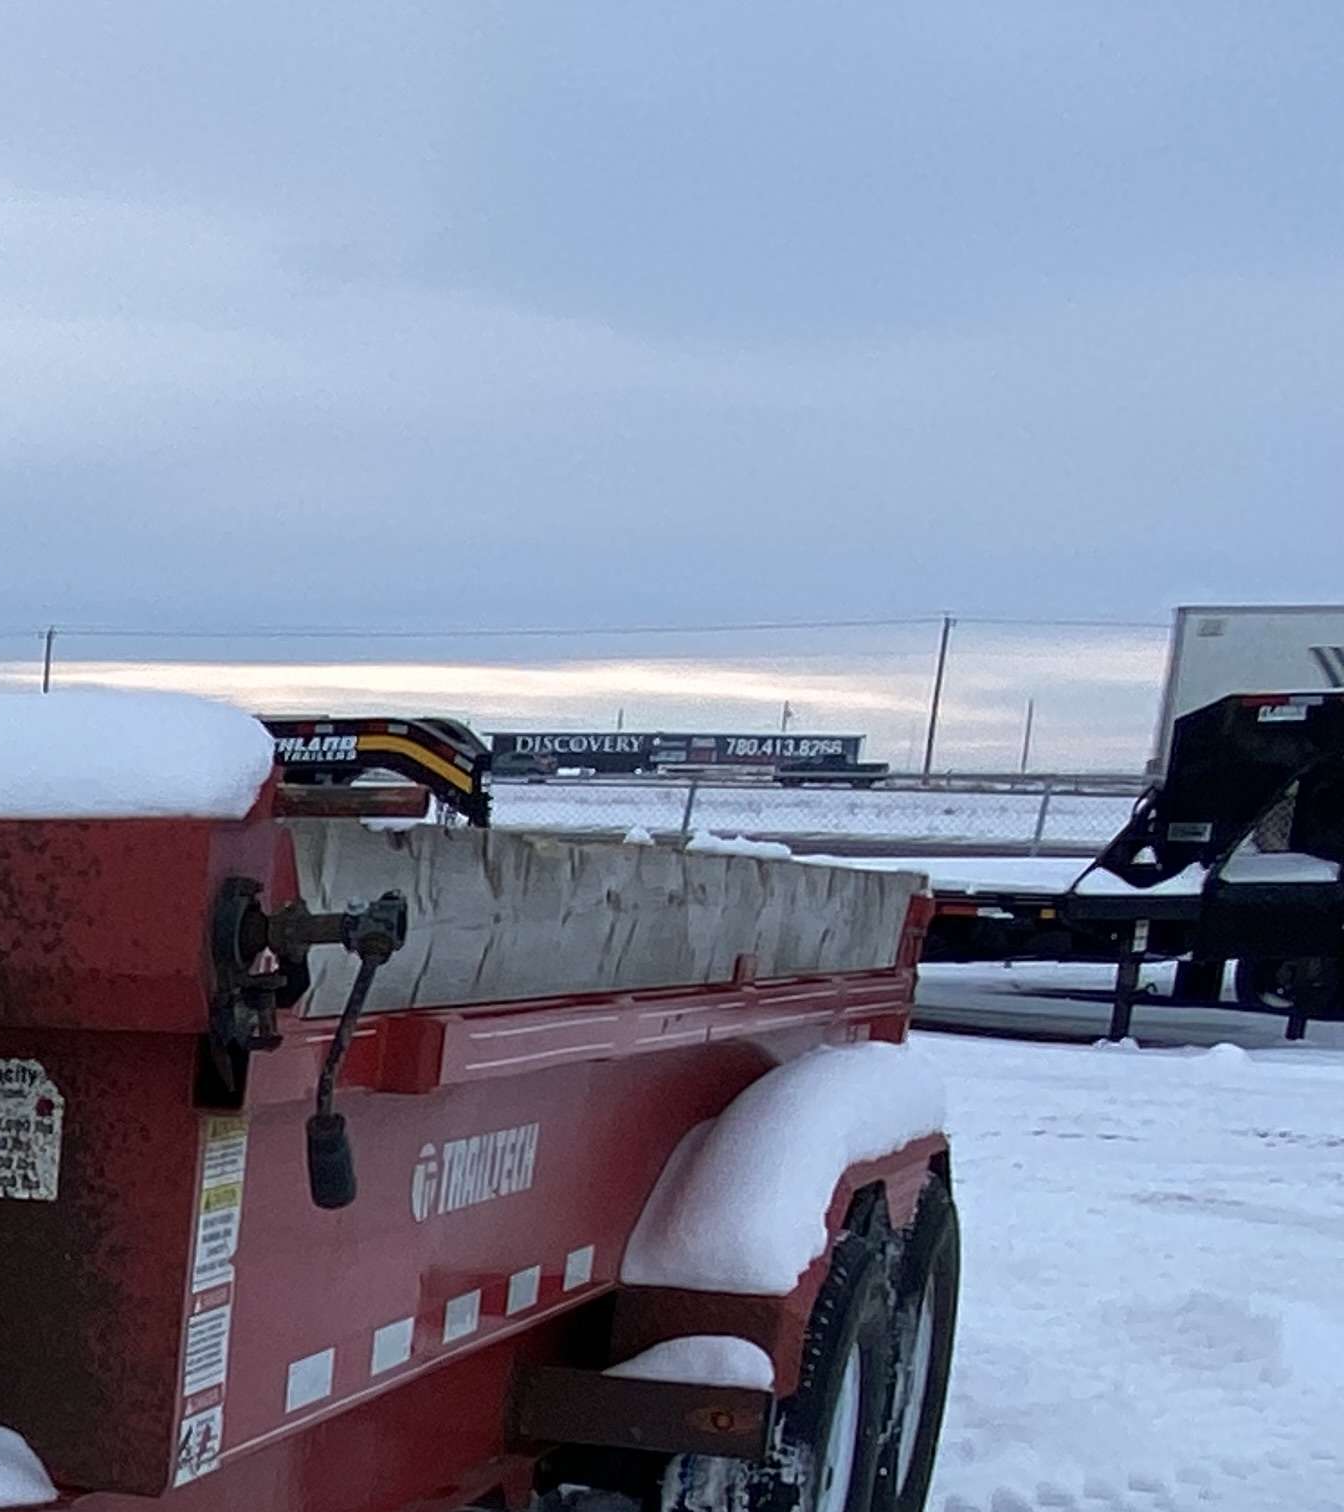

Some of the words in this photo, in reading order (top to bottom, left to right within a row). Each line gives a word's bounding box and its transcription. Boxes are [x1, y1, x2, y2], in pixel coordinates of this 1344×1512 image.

[515, 735, 644, 753] DISCOVERY
[283, 750, 356, 761] TRAILERS
[437, 1122, 540, 1215] TRAILTECH
